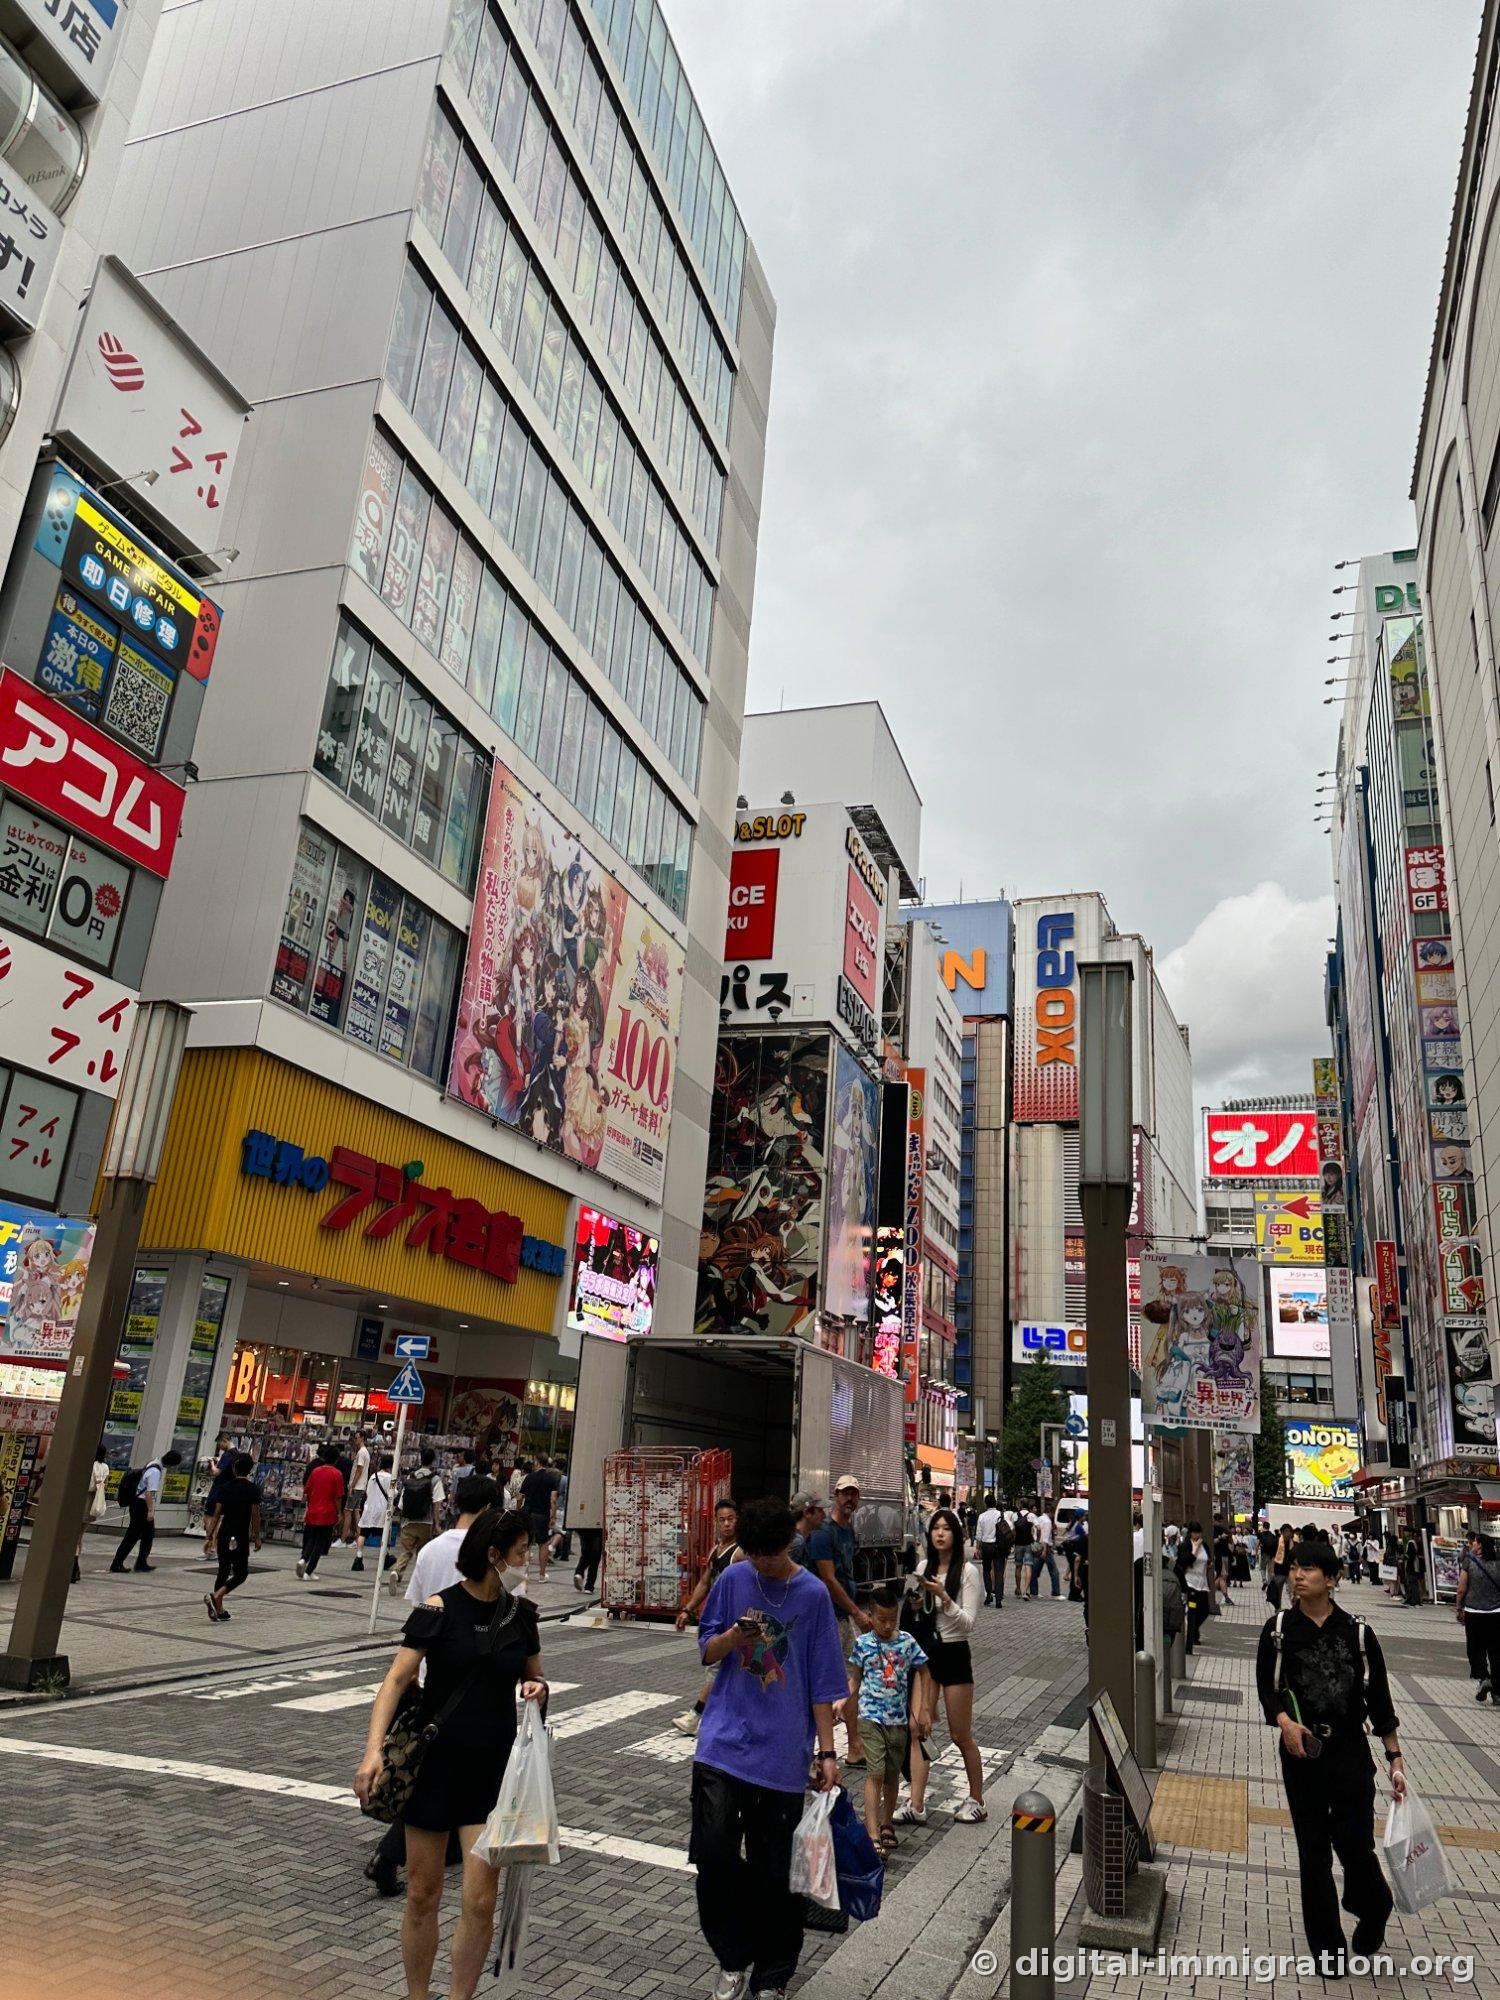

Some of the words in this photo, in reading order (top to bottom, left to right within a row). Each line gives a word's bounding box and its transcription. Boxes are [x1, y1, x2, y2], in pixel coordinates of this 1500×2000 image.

[82, 557, 177, 649] 即日修理
[95, 541, 131, 579] GAME
[133, 571, 176, 616] REPAIR
[47, 632, 104, 694] 激得
[67, 625, 100, 655] 本日の
[332, 637, 443, 772] K-BOOKS
[2, 699, 161, 851] アコム
[3, 840, 56, 880] アコムは
[0, 863, 52, 913] 金利
[729, 886, 766, 907] CE
[1415, 895, 1435, 908] 6F
[608, 1038, 616, 1070] 最大
[608, 1004, 671, 1107] 100
[609, 1086, 664, 1139] ガチャ無料!
[1211, 1121, 1319, 1168] オノ
[904, 1204, 920, 1268] ZOO
[1270, 1225, 1291, 1234] ここ!
[1437, 1184, 1467, 1312] カードゲム専門店
[1144, 1254, 1168, 1263] 17LIVE
[903, 1270, 918, 1344] 秋葉原店
